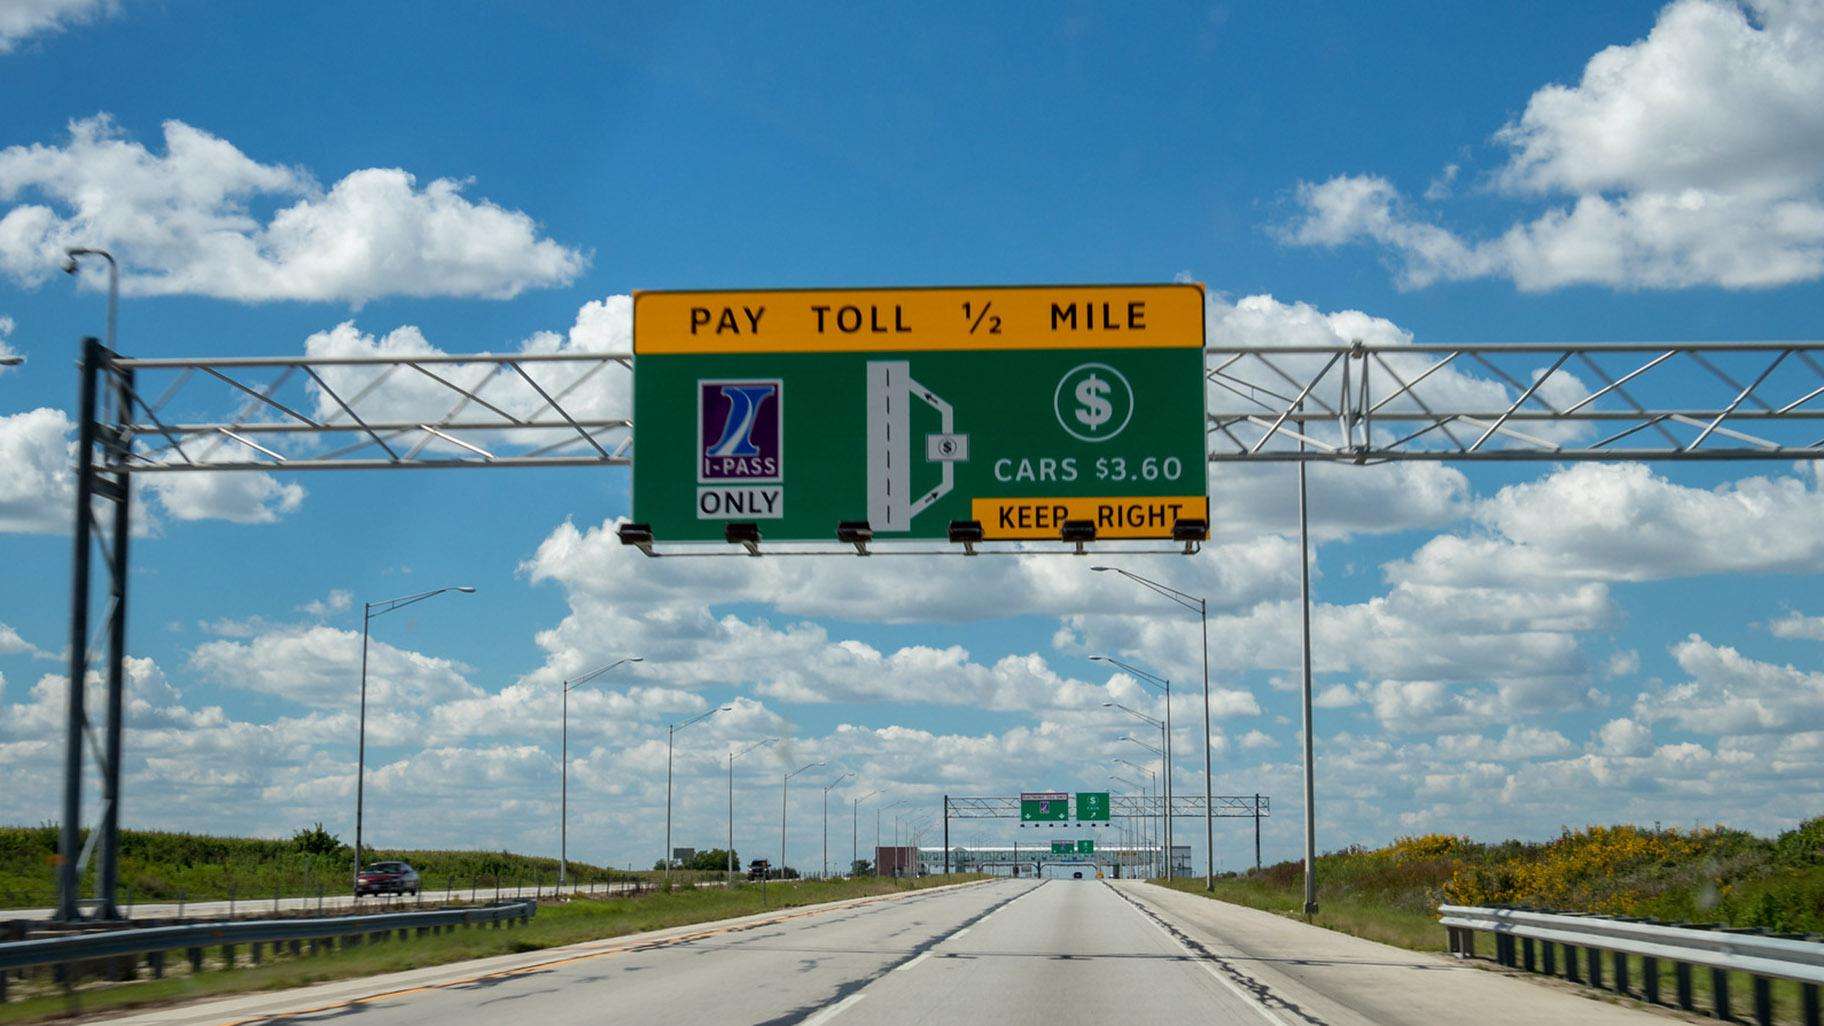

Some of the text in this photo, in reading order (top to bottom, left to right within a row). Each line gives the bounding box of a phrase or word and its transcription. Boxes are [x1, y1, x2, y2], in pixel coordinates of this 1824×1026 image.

[690, 306, 766, 335] PAY
[811, 305, 912, 333] TOLL
[1051, 302, 1146, 330] MILE
[704, 457, 777, 476] I-PASS
[994, 457, 1182, 482] CARS $3.60
[700, 491, 779, 515] ONLY
[999, 504, 1183, 529] KEEP RIGHT
